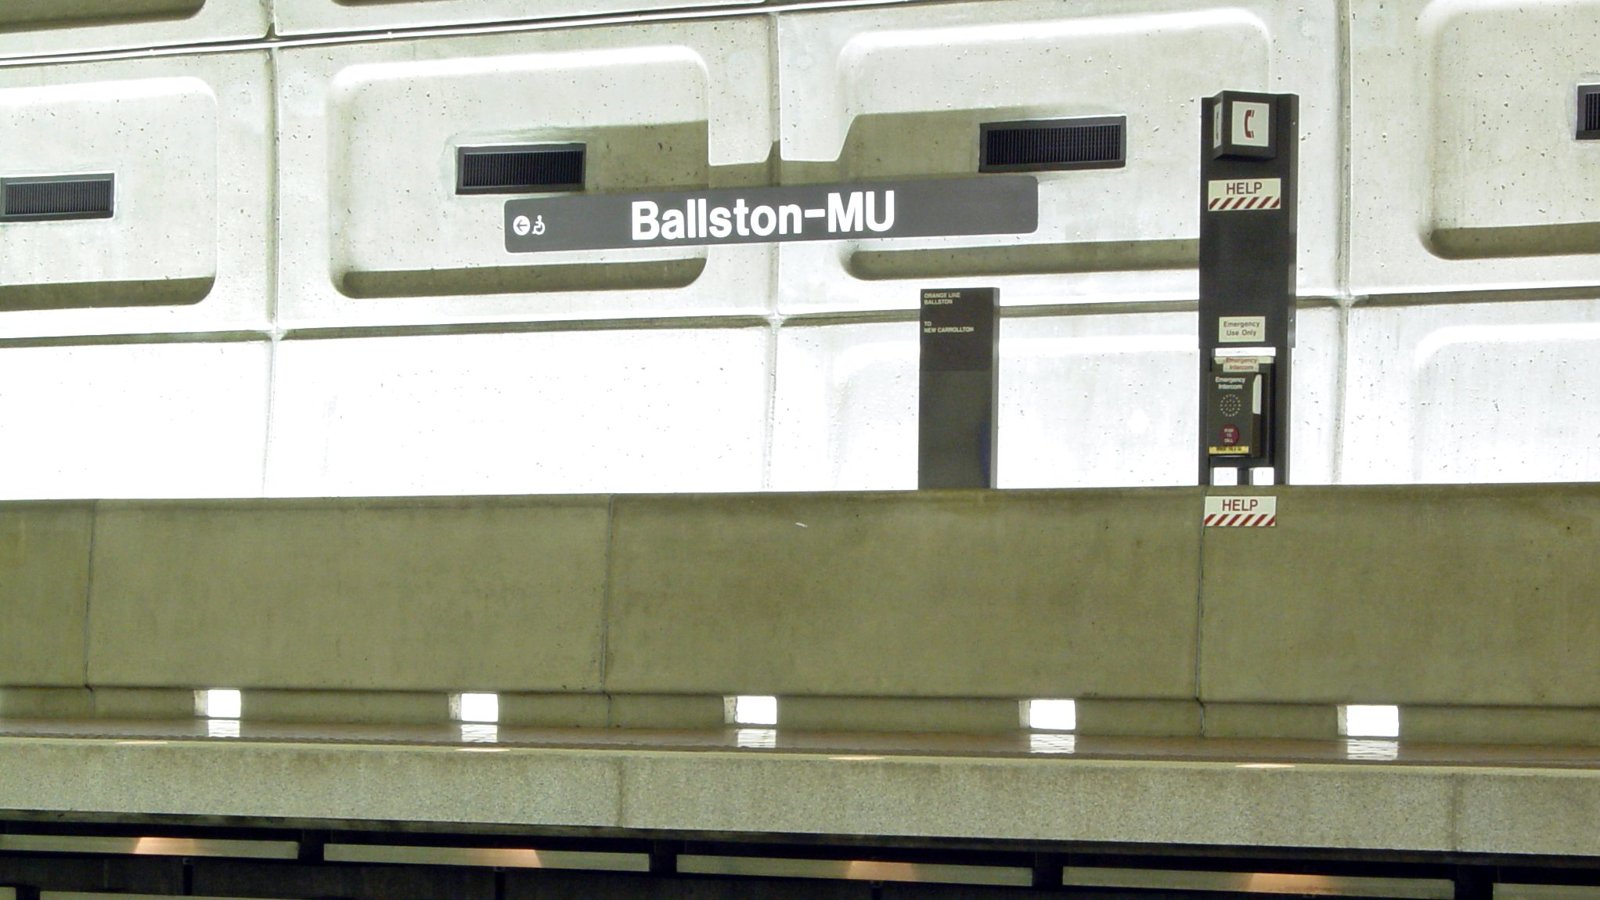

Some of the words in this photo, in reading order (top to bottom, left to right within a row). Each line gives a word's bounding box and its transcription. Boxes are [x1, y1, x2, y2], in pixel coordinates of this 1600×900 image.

[1226, 181, 1263, 195] HELP
[631, 190, 895, 240] Ballston-MU
[1223, 320, 1260, 328] Emergency
[1226, 329, 1240, 337] Use
[1241, 328, 1257, 337] Only
[1222, 499, 1258, 512] HELP
